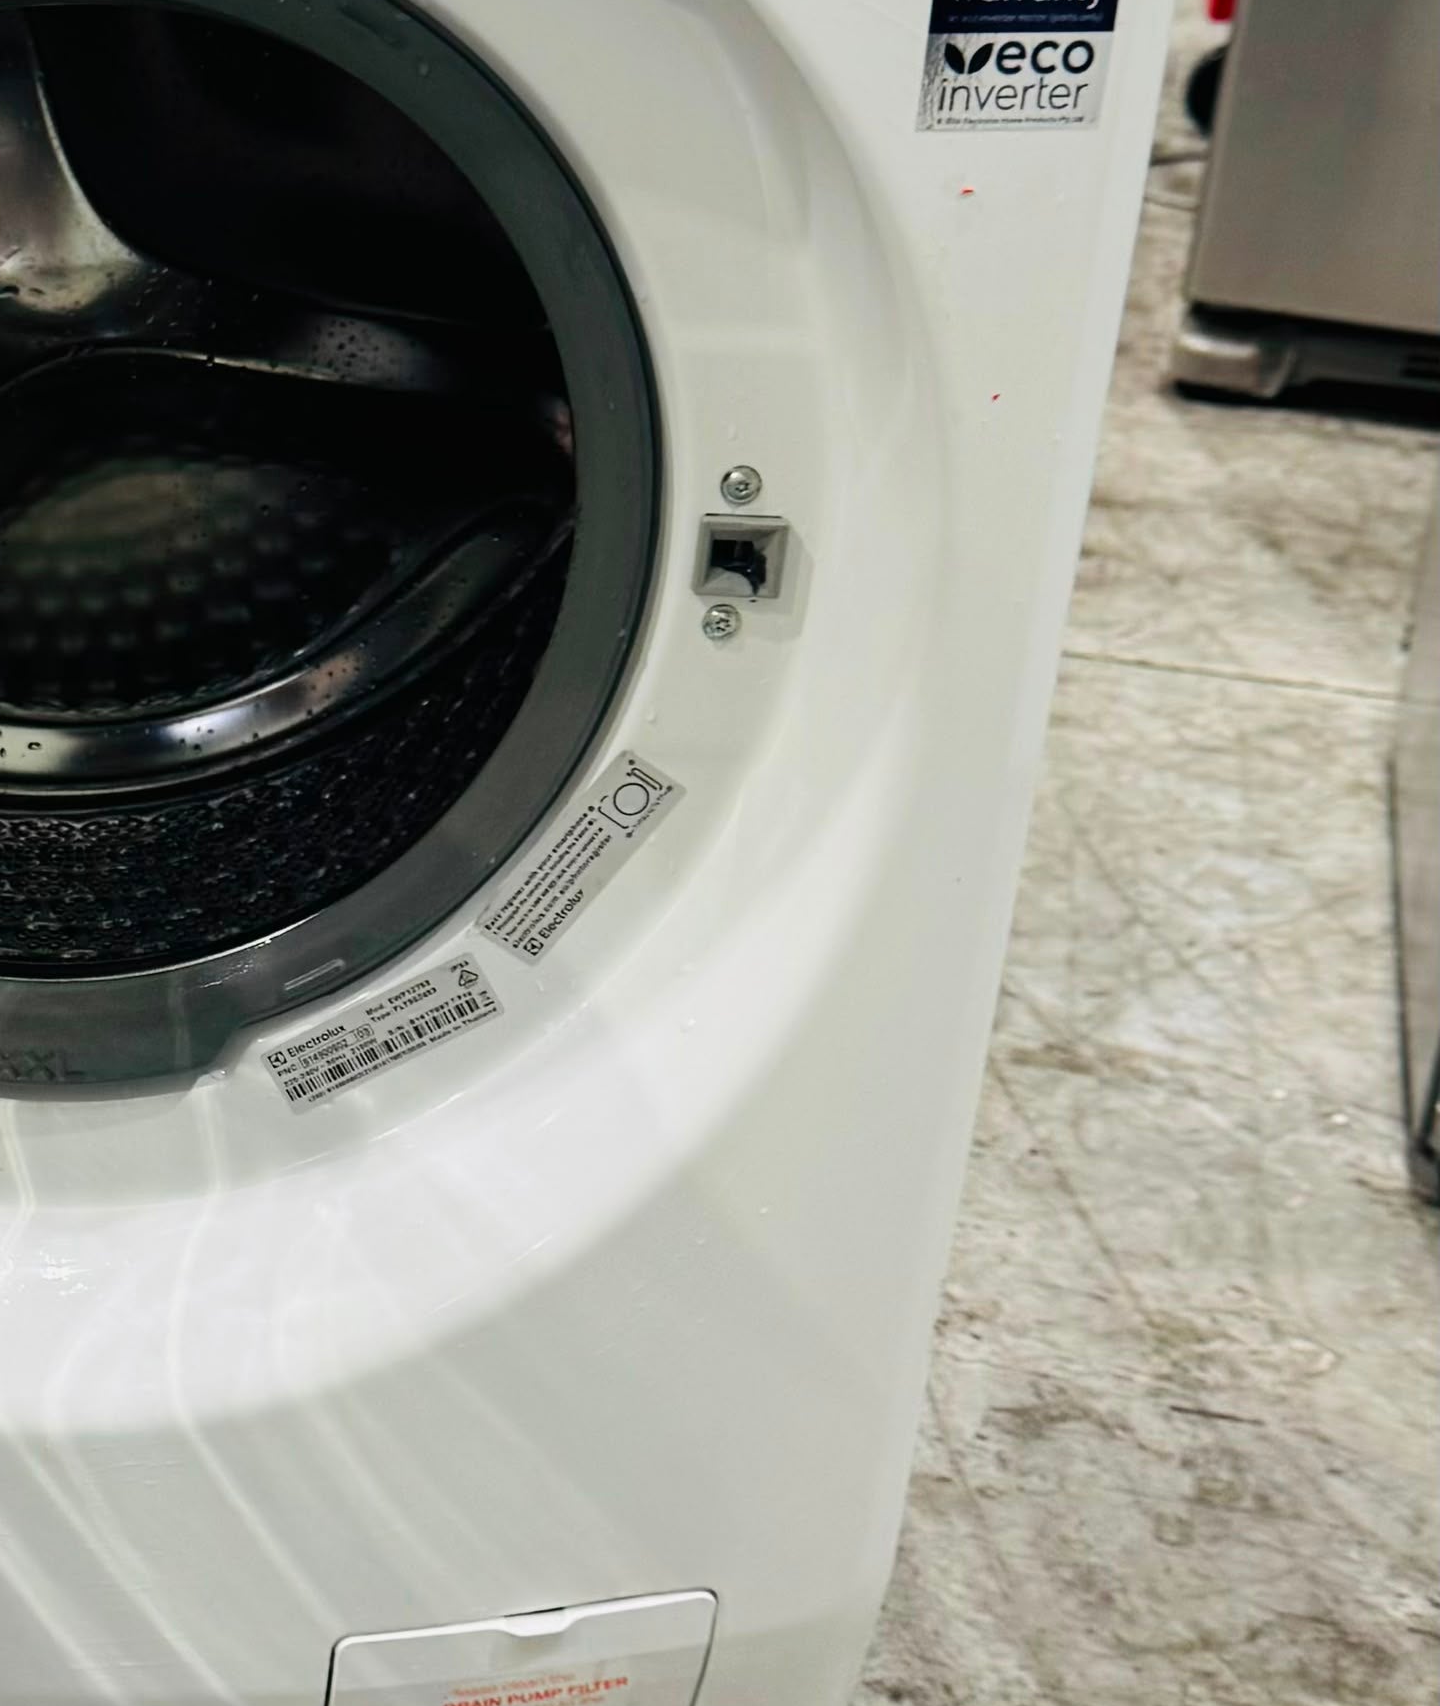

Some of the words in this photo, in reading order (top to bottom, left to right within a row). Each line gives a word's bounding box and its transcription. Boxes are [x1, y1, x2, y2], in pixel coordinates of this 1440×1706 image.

[995, 39, 1095, 75] eco
[938, 77, 1090, 111] inverter
[287, 1025, 346, 1057] Electrolux
[507, 1687, 563, 1706] PUMP
[568, 1676, 629, 1695] FILTER
